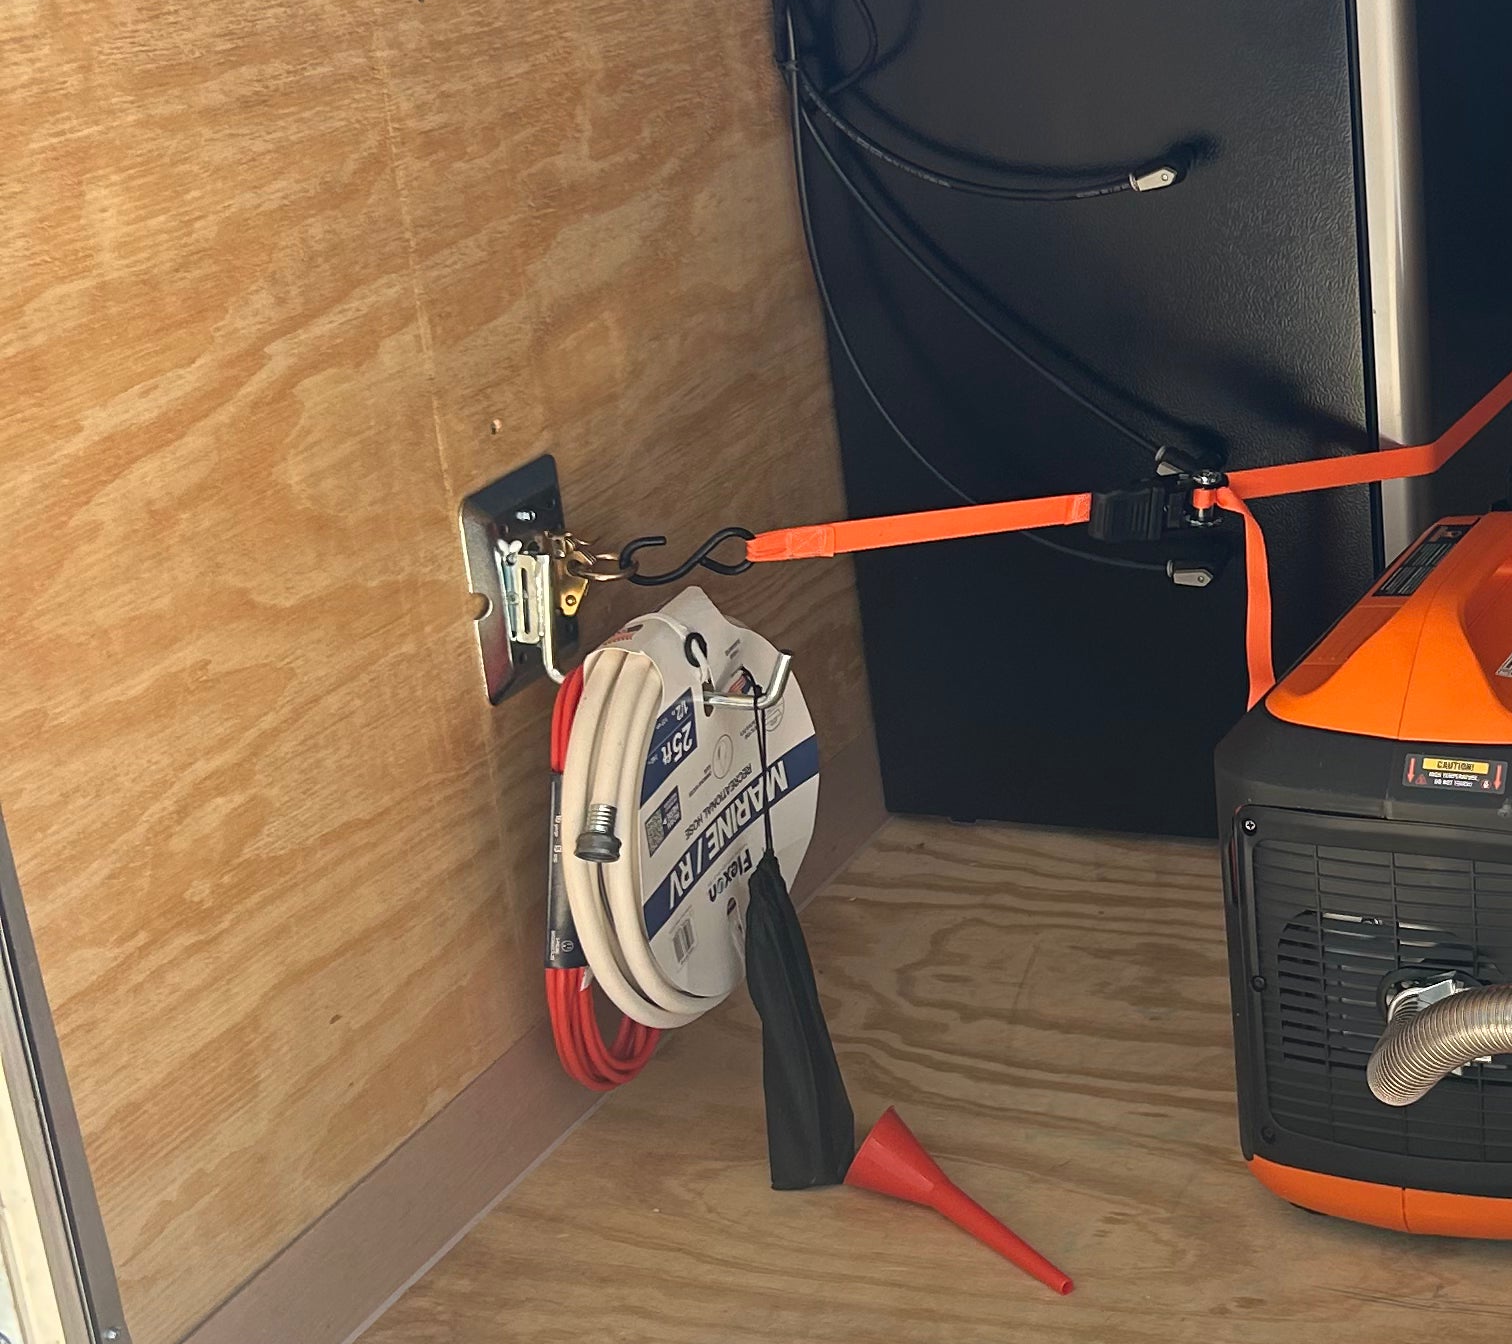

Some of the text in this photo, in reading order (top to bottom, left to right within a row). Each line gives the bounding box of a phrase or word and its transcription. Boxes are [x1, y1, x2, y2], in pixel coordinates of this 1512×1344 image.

[703, 763, 752, 818] RECREATIONAL
[1437, 761, 1475, 772] CAUTION!
[706, 760, 788, 860] MARINE
[670, 852, 694, 910] RV
[708, 848, 753, 903] Flexon
